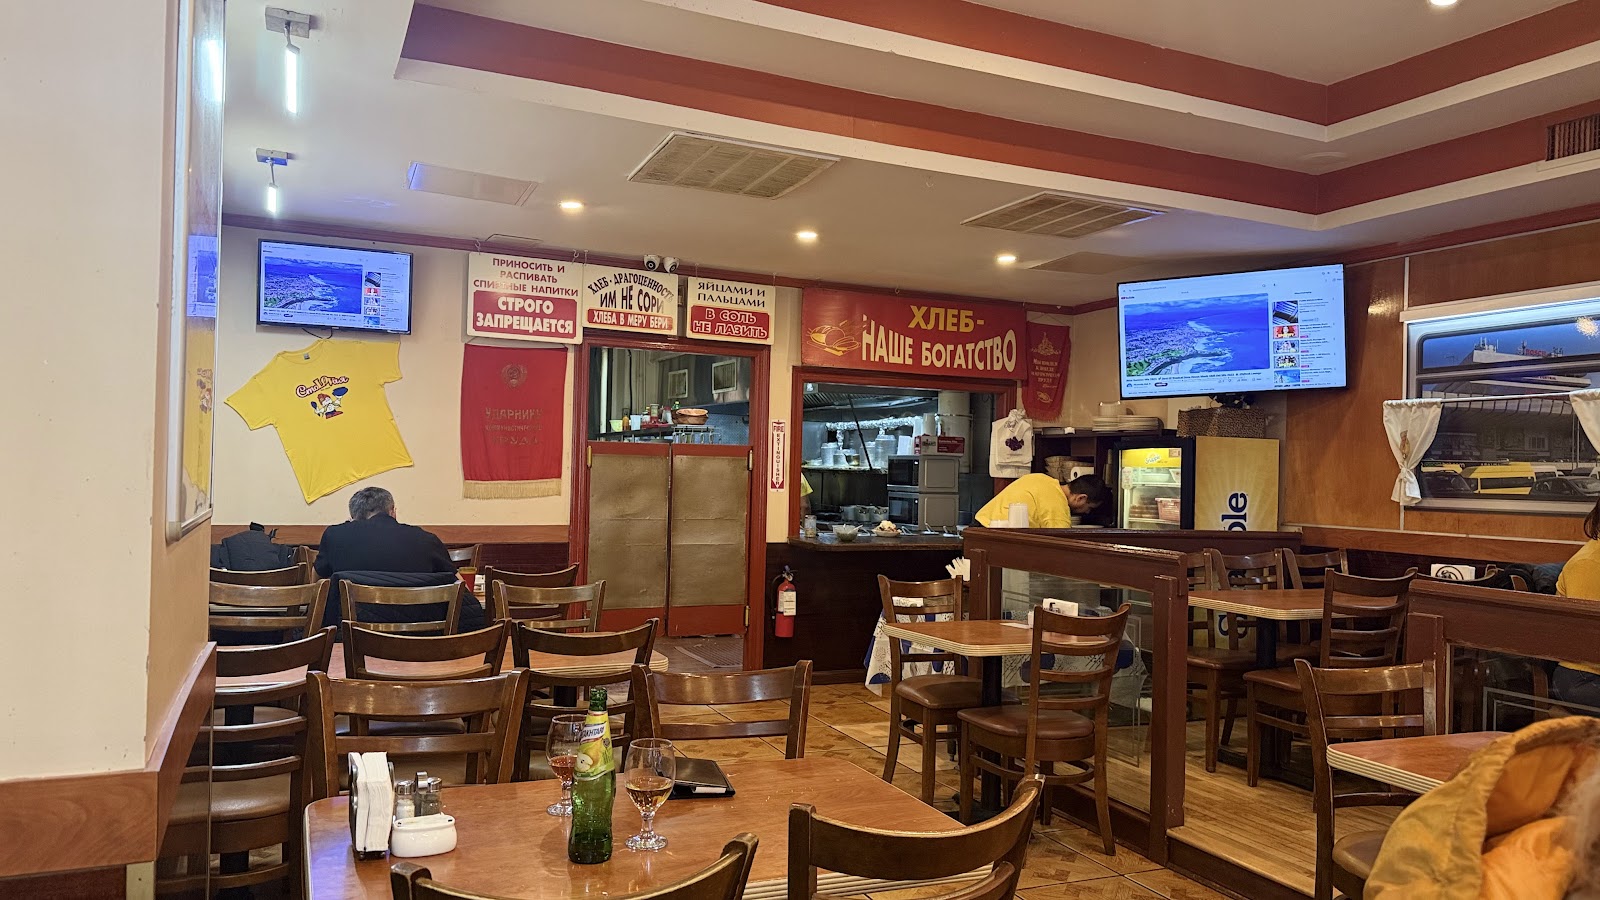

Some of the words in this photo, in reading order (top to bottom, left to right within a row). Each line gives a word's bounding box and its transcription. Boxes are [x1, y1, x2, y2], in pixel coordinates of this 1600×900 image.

[492, 258, 553, 272] ПРИНОСИТЬ
[557, 265, 565, 273] И
[500, 270, 558, 283] РАСПИВАТЬ
[531, 285, 579, 297] НАПИТКИ
[697, 281, 753, 296] ЯЙЦАМИ
[756, 288, 766, 297] И
[497, 296, 554, 314] СТРОГО
[600, 289, 617, 309] ИМ
[621, 285, 634, 310] НЕ
[637, 288, 665, 314] СОРИ
[697, 293, 766, 308] ПАЛЬЦАМИ
[476, 312, 574, 334] ЗАПРЕЩАЕТСЯ
[592, 311, 617, 325] ХЛЕБА
[619, 313, 625, 325] В
[627, 314, 647, 328] МЕРУ
[649, 316, 668, 330] БЕРИ
[705, 308, 716, 320] В
[719, 310, 757, 325] СОЛЬ
[907, 304, 985, 333] ХЛЕБ-
[692, 320, 711, 334] НЕ
[714, 323, 768, 339] ЛАЗИТЬ
[861, 314, 914, 366] НАШЕ
[921, 329, 1017, 373] БОГАТСТВО
[773, 425, 784, 433] FIRE
